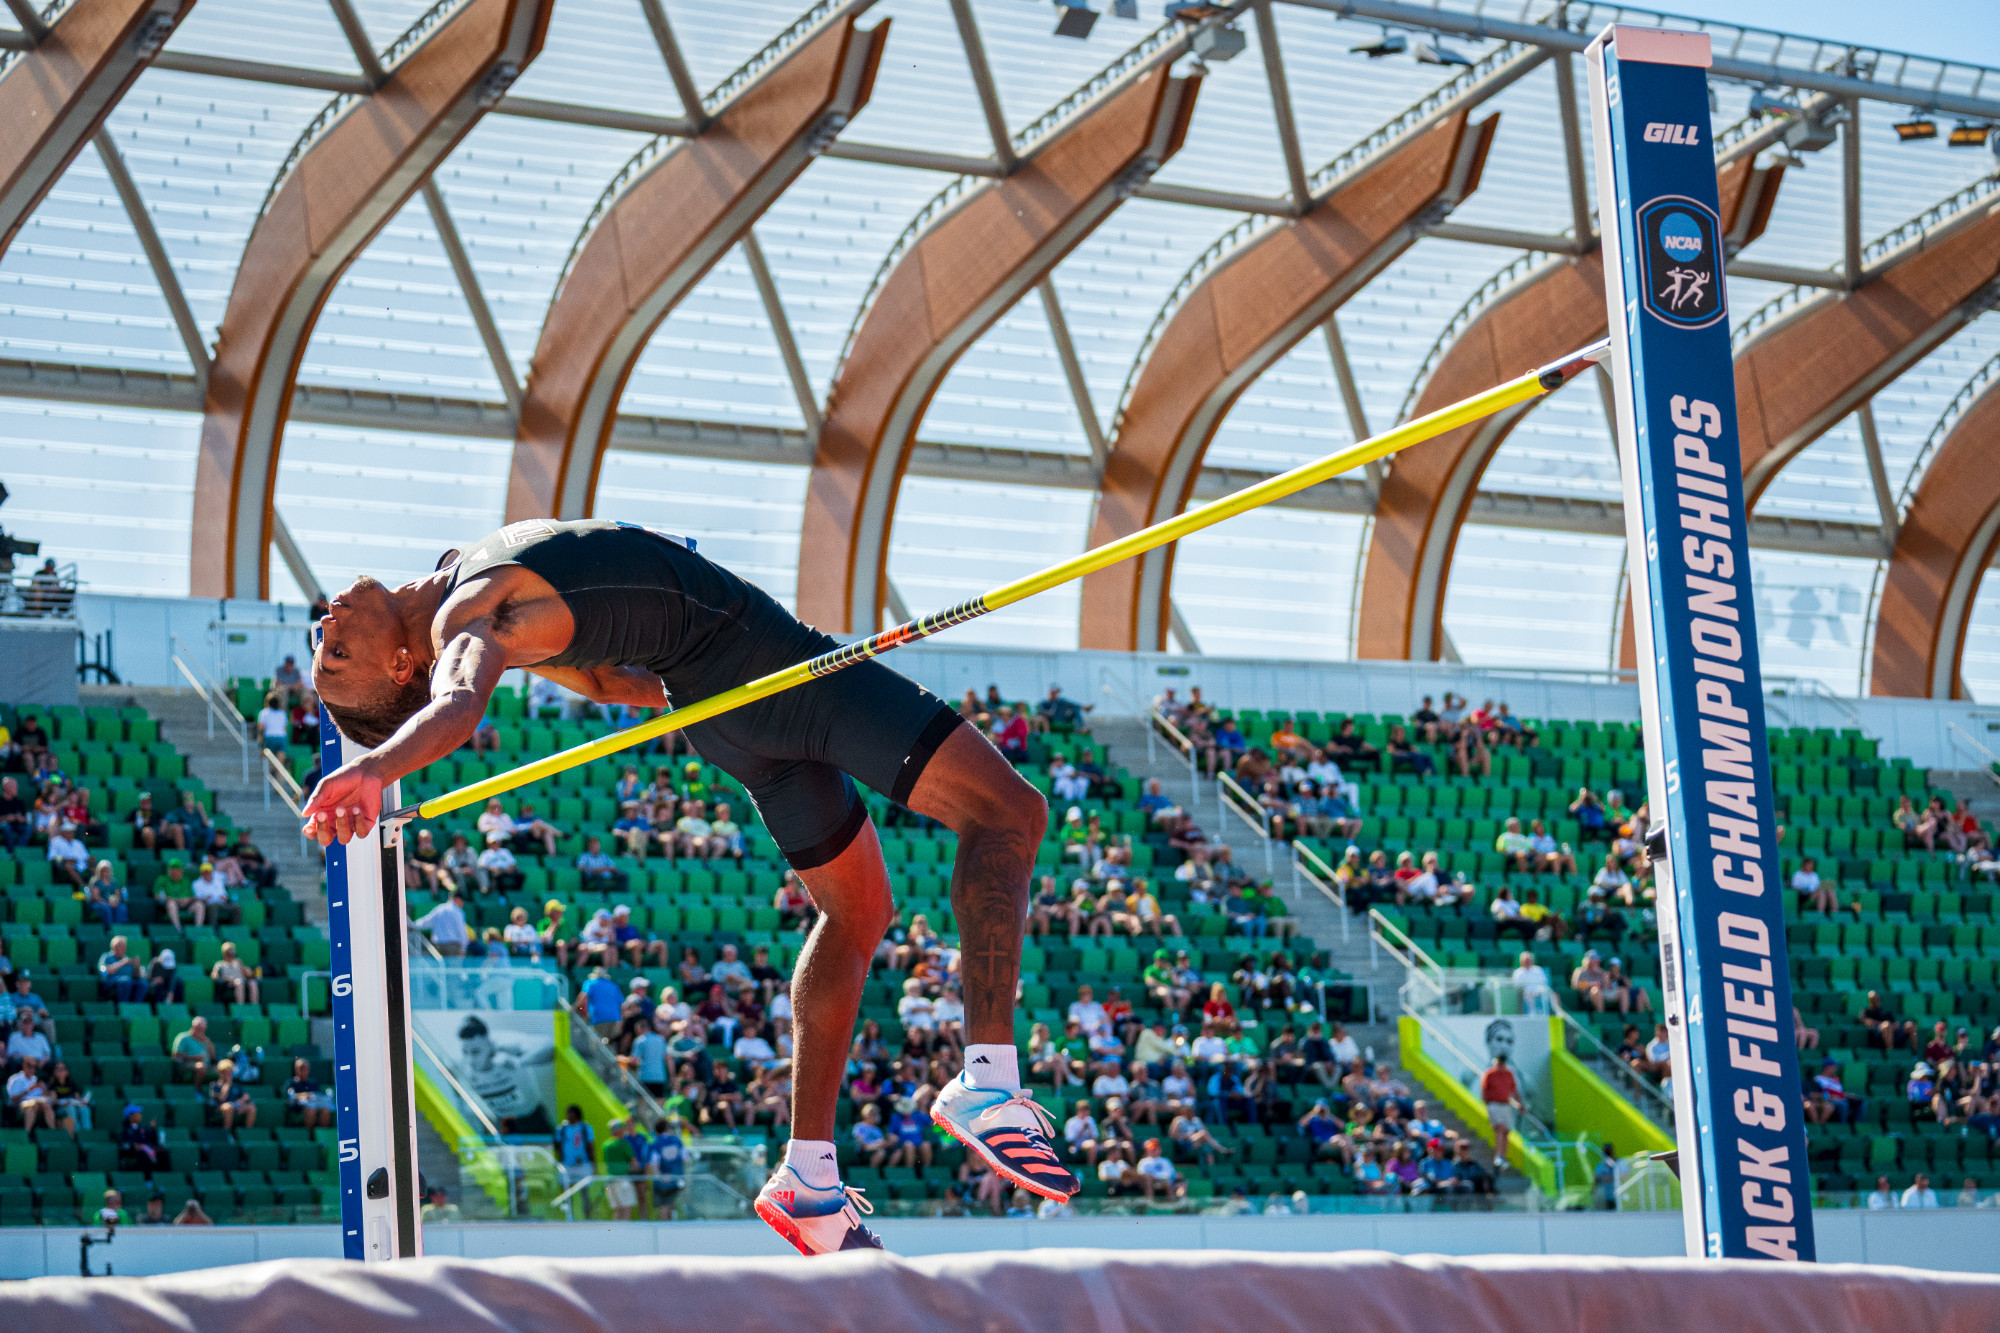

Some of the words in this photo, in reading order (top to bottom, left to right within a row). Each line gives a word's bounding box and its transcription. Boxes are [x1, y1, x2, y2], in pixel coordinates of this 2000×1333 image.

[1607, 74, 1620, 108] 8
[1643, 122, 1699, 146] GILL
[1665, 235, 1702, 251] NCAA
[1647, 526, 1658, 562] 6
[877, 620, 912, 649] GILL
[1670, 394, 1765, 897] CHAMPIONSHIPS
[1665, 759, 1680, 795] 5
[332, 973, 352, 997] 6
[1718, 911, 1782, 1077] FIELD
[1688, 994, 1703, 1026] 4
[1733, 1086, 1787, 1132] &
[340, 1139, 359, 1162] 5
[1708, 1231, 1722, 1260] 3
